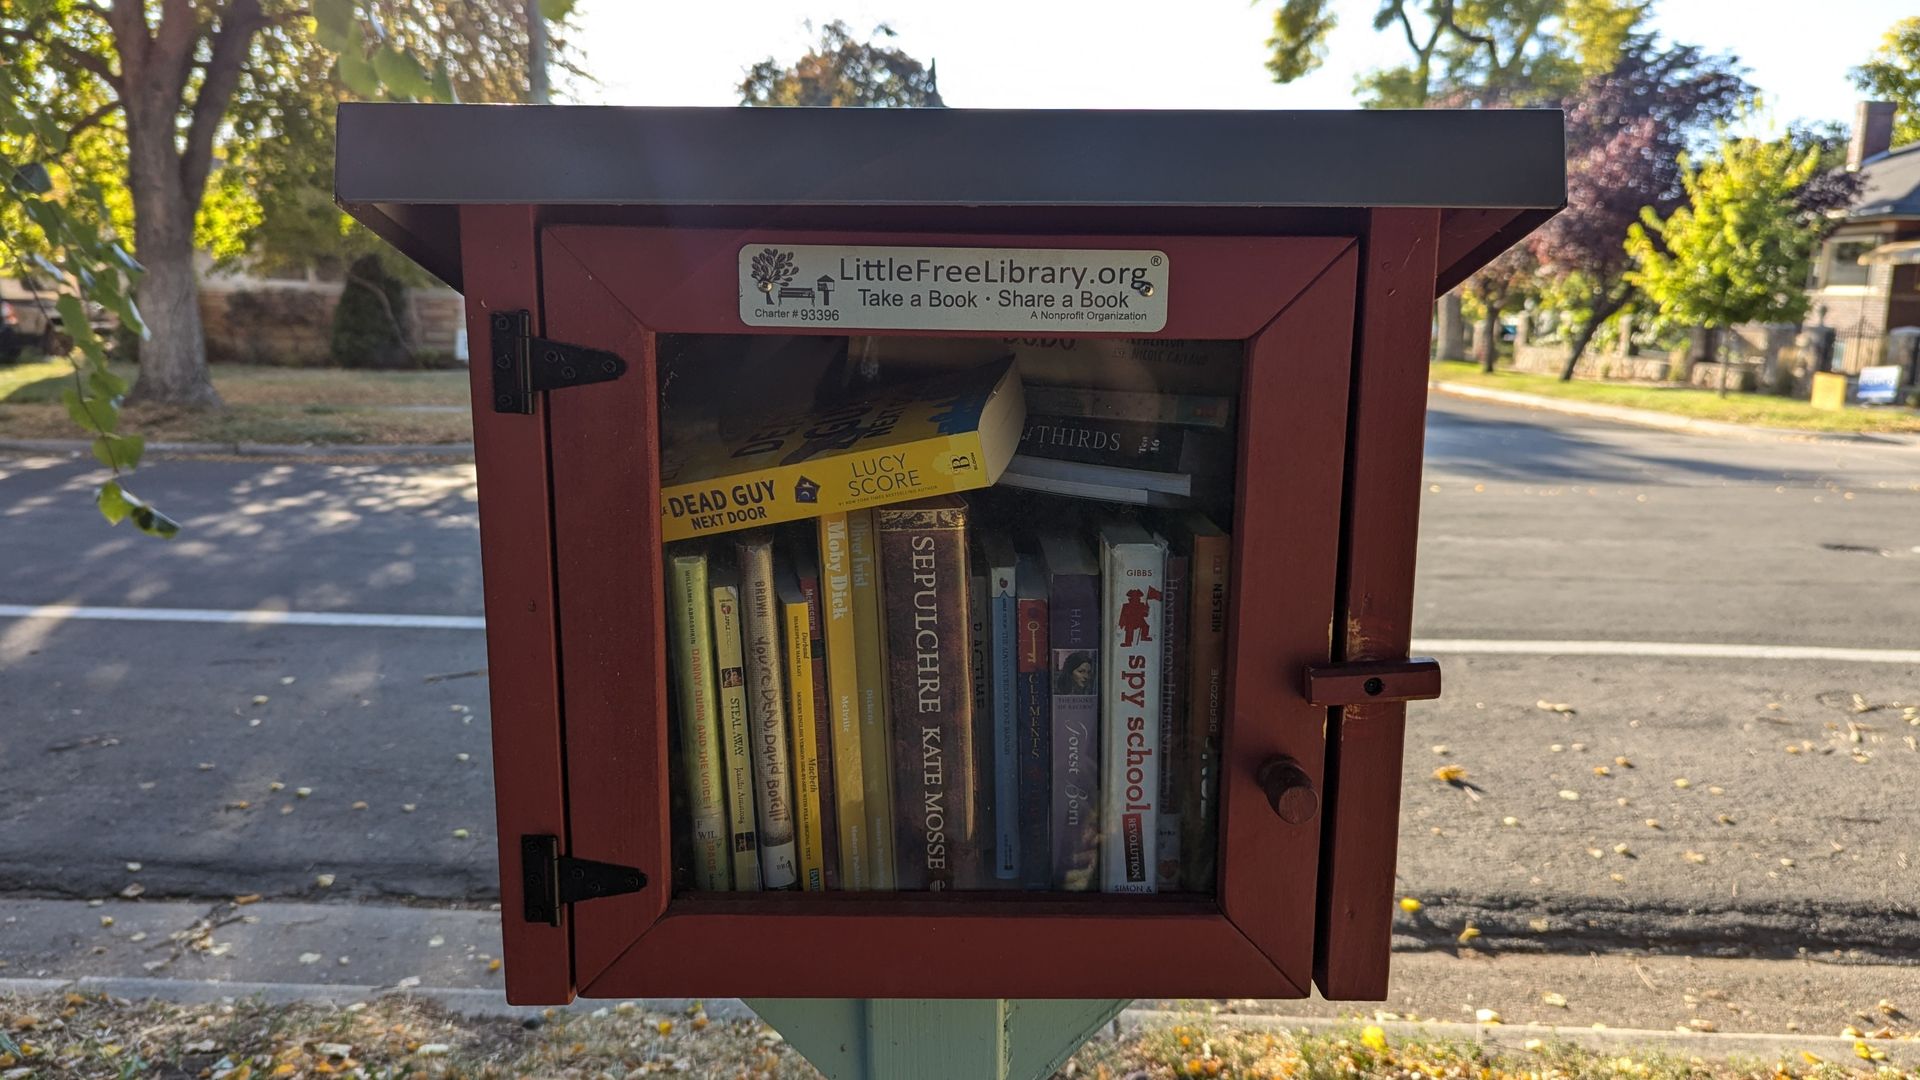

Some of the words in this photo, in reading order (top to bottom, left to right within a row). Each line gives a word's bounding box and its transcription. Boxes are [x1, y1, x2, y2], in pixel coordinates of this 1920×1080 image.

[841, 257, 1149, 292] LittleFreeLibrary.org
[754, 308, 791, 319] Charter
[792, 309, 799, 318] #
[800, 310, 840, 322] 93396
[858, 289, 905, 307] Take
[910, 295, 922, 307] a
[930, 290, 979, 308] Book
[998, 290, 1055, 308] Share
[1062, 296, 1073, 308] a
[1081, 291, 1130, 308] Book
[1030, 311, 1039, 320] A
[1041, 311, 1084, 322] Nonprofit
[1087, 312, 1147, 322] Organization
[1037, 425, 1121, 451] THIRDS
[848, 470, 921, 497] SCORE
[851, 453, 906, 478] LUCY
[668, 489, 728, 518] DEAD
[731, 480, 775, 507] GUY
[691, 512, 725, 530] NEXT
[727, 506, 768, 524] DOOR
[825, 520, 846, 573] Moby
[850, 519, 870, 554] Oliver
[685, 570, 695, 604] WILLIAMS
[853, 554, 872, 588] Twist
[754, 581, 768, 618] BROWN
[830, 574, 849, 620] Dick
[1211, 583, 1223, 633] NIELSEN
[687, 607, 698, 646] ABRASHKIN
[912, 536, 941, 713] SEPULCHRE
[1002, 631, 1010, 646] THE
[1070, 608, 1081, 645] HALE
[801, 632, 810, 660] Durband
[690, 648, 702, 688] DANNY
[1002, 647, 1011, 692] ADVENTURES
[1121, 655, 1147, 708] spy
[694, 690, 705, 721] DUNN
[730, 697, 742, 730] STEAL
[761, 689, 778, 733] DEAD,
[841, 695, 851, 733] Melville
[1208, 668, 1220, 733] DEADZONE
[697, 725, 707, 747] AND
[734, 731, 744, 757] AWAY
[1063, 721, 1089, 775] Forest
[699, 750, 709, 770] THE
[763, 734, 783, 775] David
[922, 726, 943, 785] KATE
[1126, 717, 1153, 812] school
[702, 772, 712, 801] VOICE
[734, 767, 745, 791] Jennifer
[808, 758, 819, 793] Macbeth
[738, 792, 747, 825] Armstrong
[766, 779, 792, 823] Borelli
[1063, 784, 1089, 826] Born
[925, 791, 946, 870] MOSSE
[1127, 818, 1142, 880] REVOLUTION
